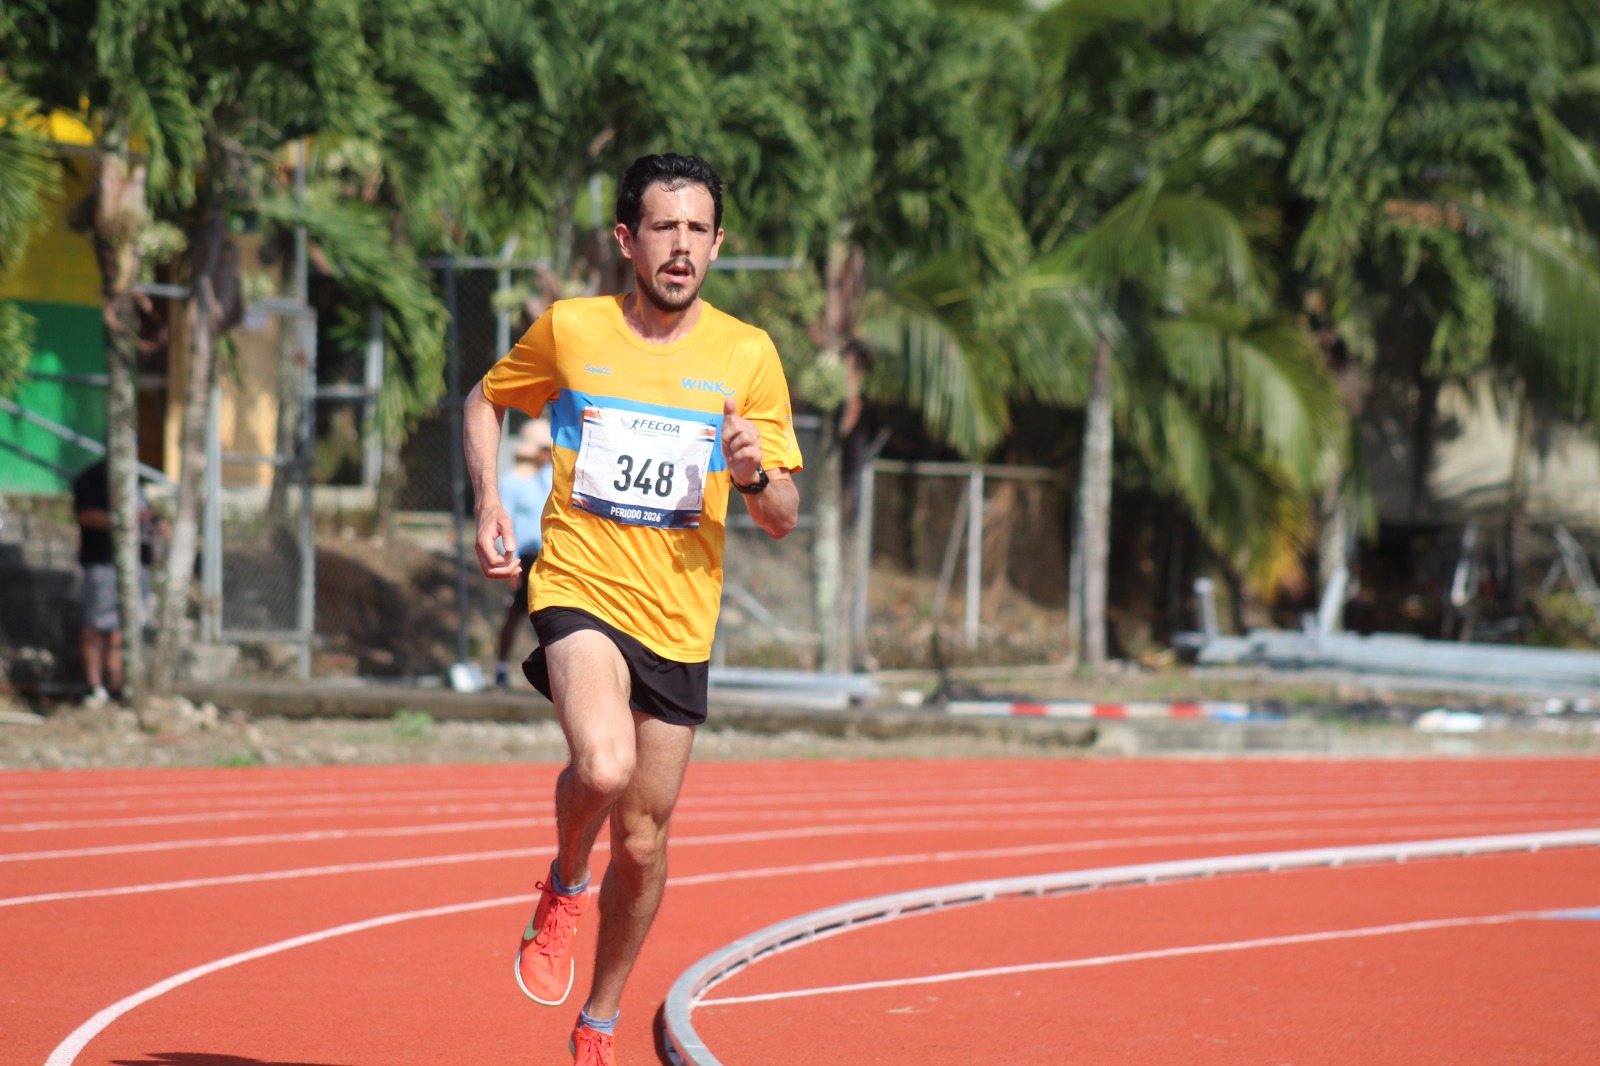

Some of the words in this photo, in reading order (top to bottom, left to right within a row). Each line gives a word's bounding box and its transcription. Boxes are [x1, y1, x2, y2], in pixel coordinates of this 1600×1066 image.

[681, 377, 736, 397] WINK
[640, 419, 681, 434] FECOA
[613, 454, 674, 497] 348
[610, 506, 642, 520] PERIODO
[642, 511, 661, 522] 2026
